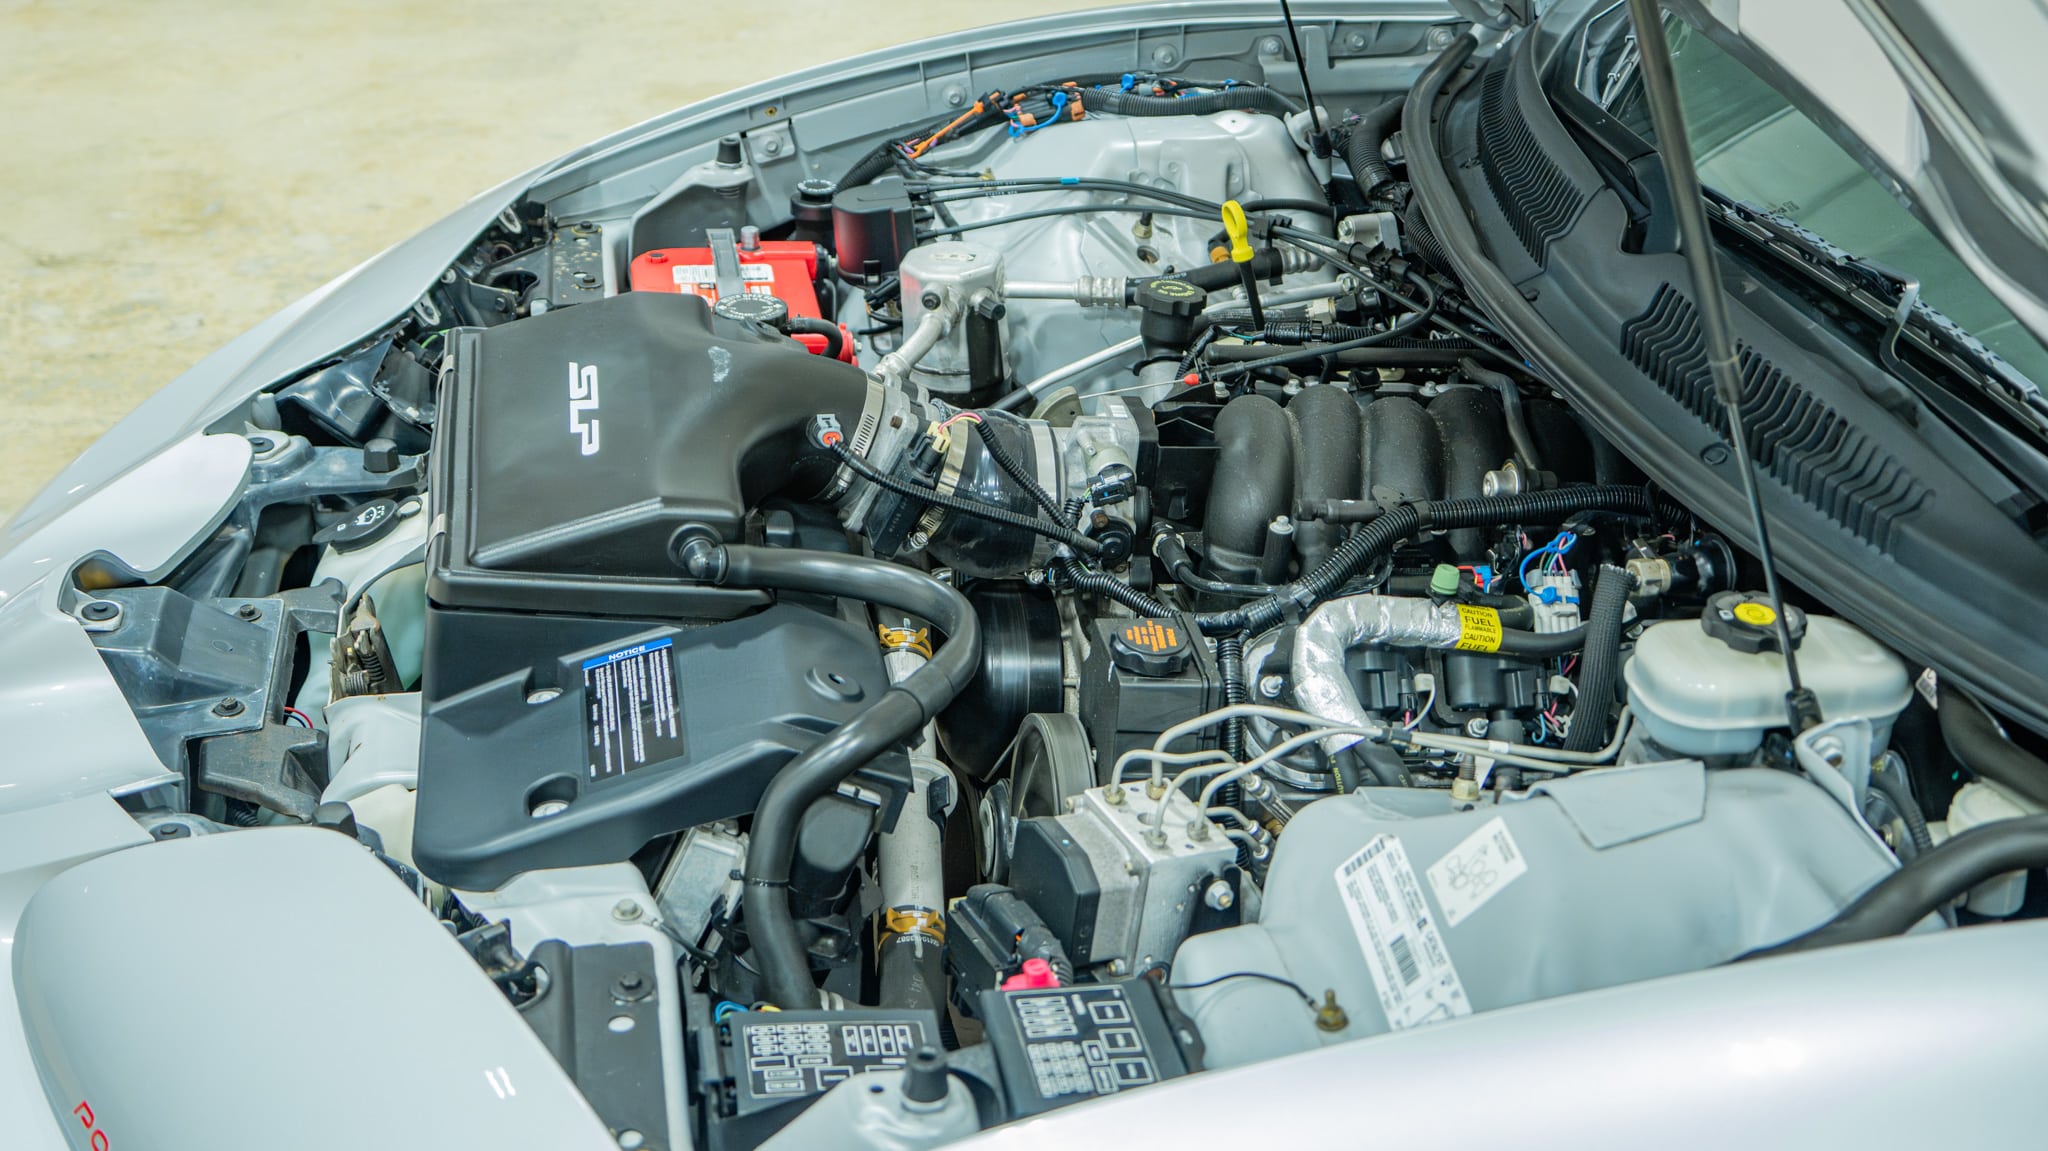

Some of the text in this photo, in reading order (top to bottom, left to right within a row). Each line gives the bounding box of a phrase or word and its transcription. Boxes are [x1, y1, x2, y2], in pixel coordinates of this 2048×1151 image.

[569, 362, 600, 456] SLP
[1462, 607, 1493, 618] CAUTION
[1465, 615, 1496, 627] FUEL
[1464, 632, 1496, 644] CAUTION
[608, 645, 646, 661] NOTICE
